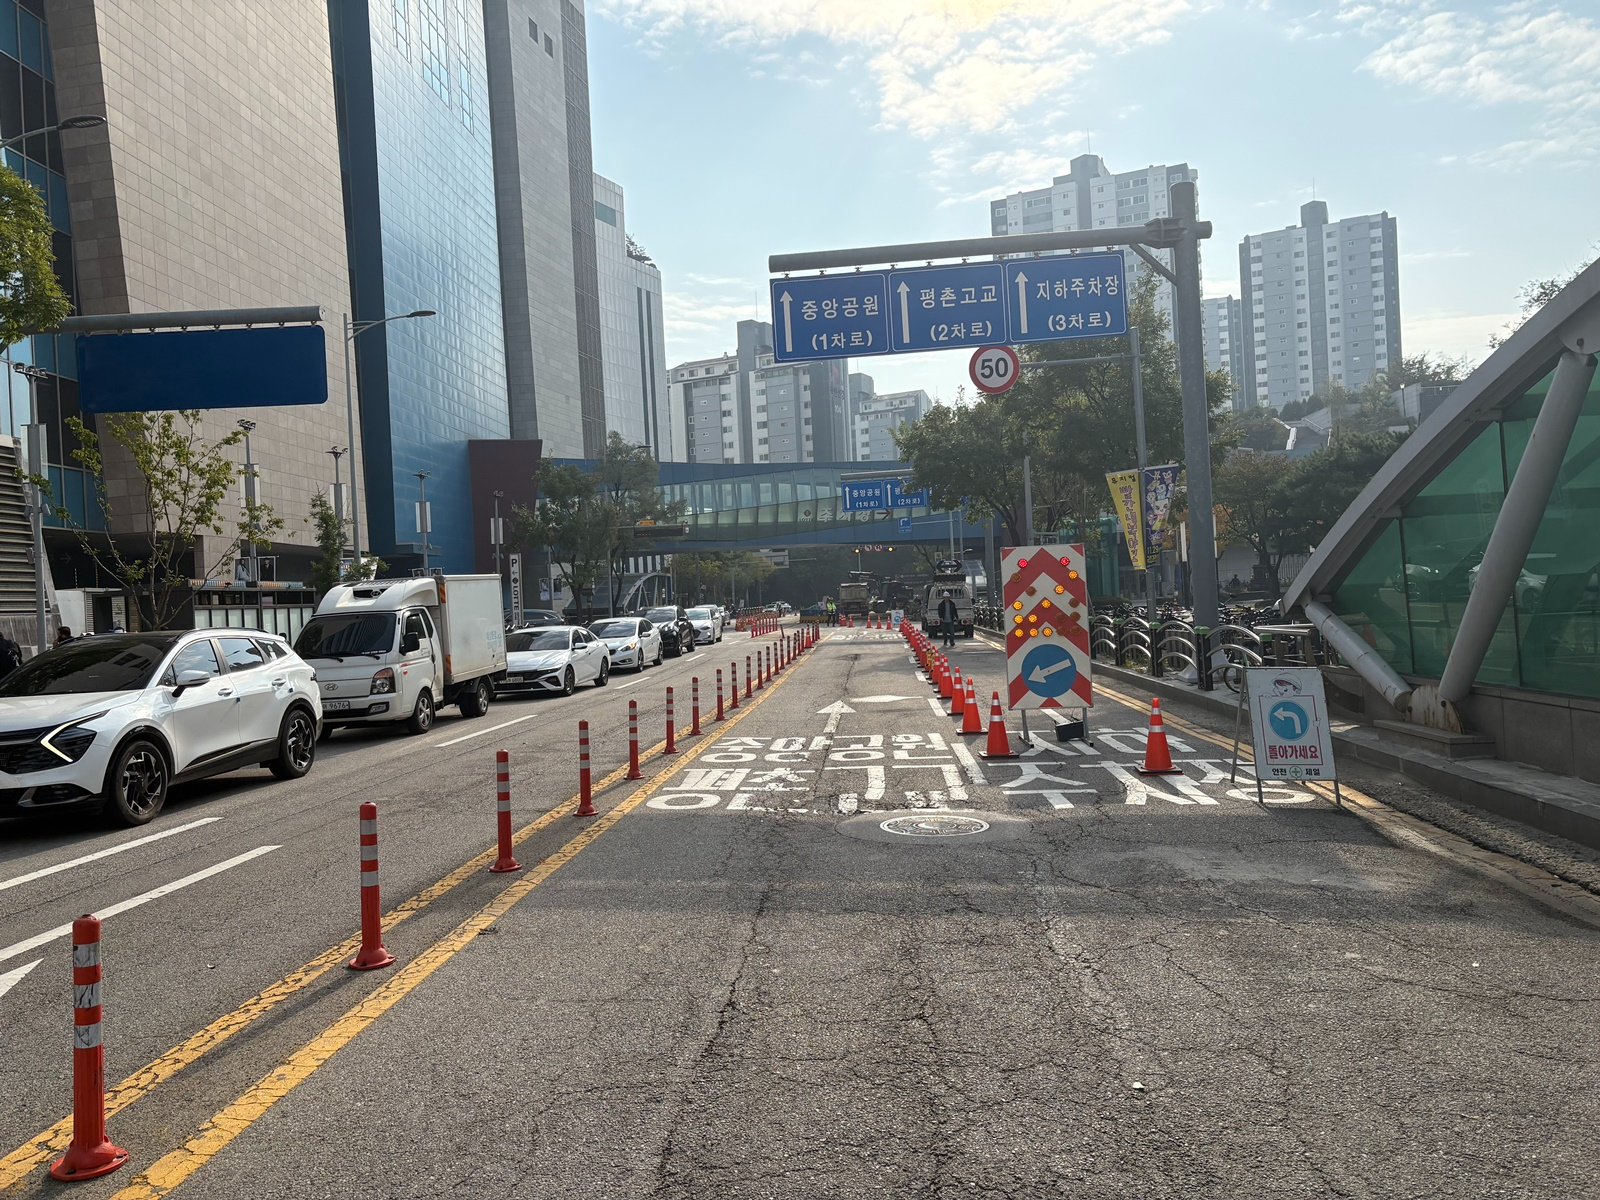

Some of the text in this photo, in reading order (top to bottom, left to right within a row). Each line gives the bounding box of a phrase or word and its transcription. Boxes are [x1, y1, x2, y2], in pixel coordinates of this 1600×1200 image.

[919, 284, 998, 310] 평촌고교
[1036, 273, 1120, 301] 지하주차장
[801, 294, 880, 321] 중앙공원
[930, 320, 993, 343] (2차로)
[1048, 310, 1112, 333] (3차로)
[811, 330, 873, 351] (1차로)
[980, 357, 1009, 379] 50
[1111, 474, 1136, 485] 뮤지컬
[852, 487, 881, 498] 중앙공원
[897, 498, 921, 506] (2차로)
[511, 558, 518, 568] P
[700, 733, 953, 763] 중앙공원
[1268, 745, 1319, 760] 돌아가세요
[1272, 768, 1320, 776] 안전 제일
